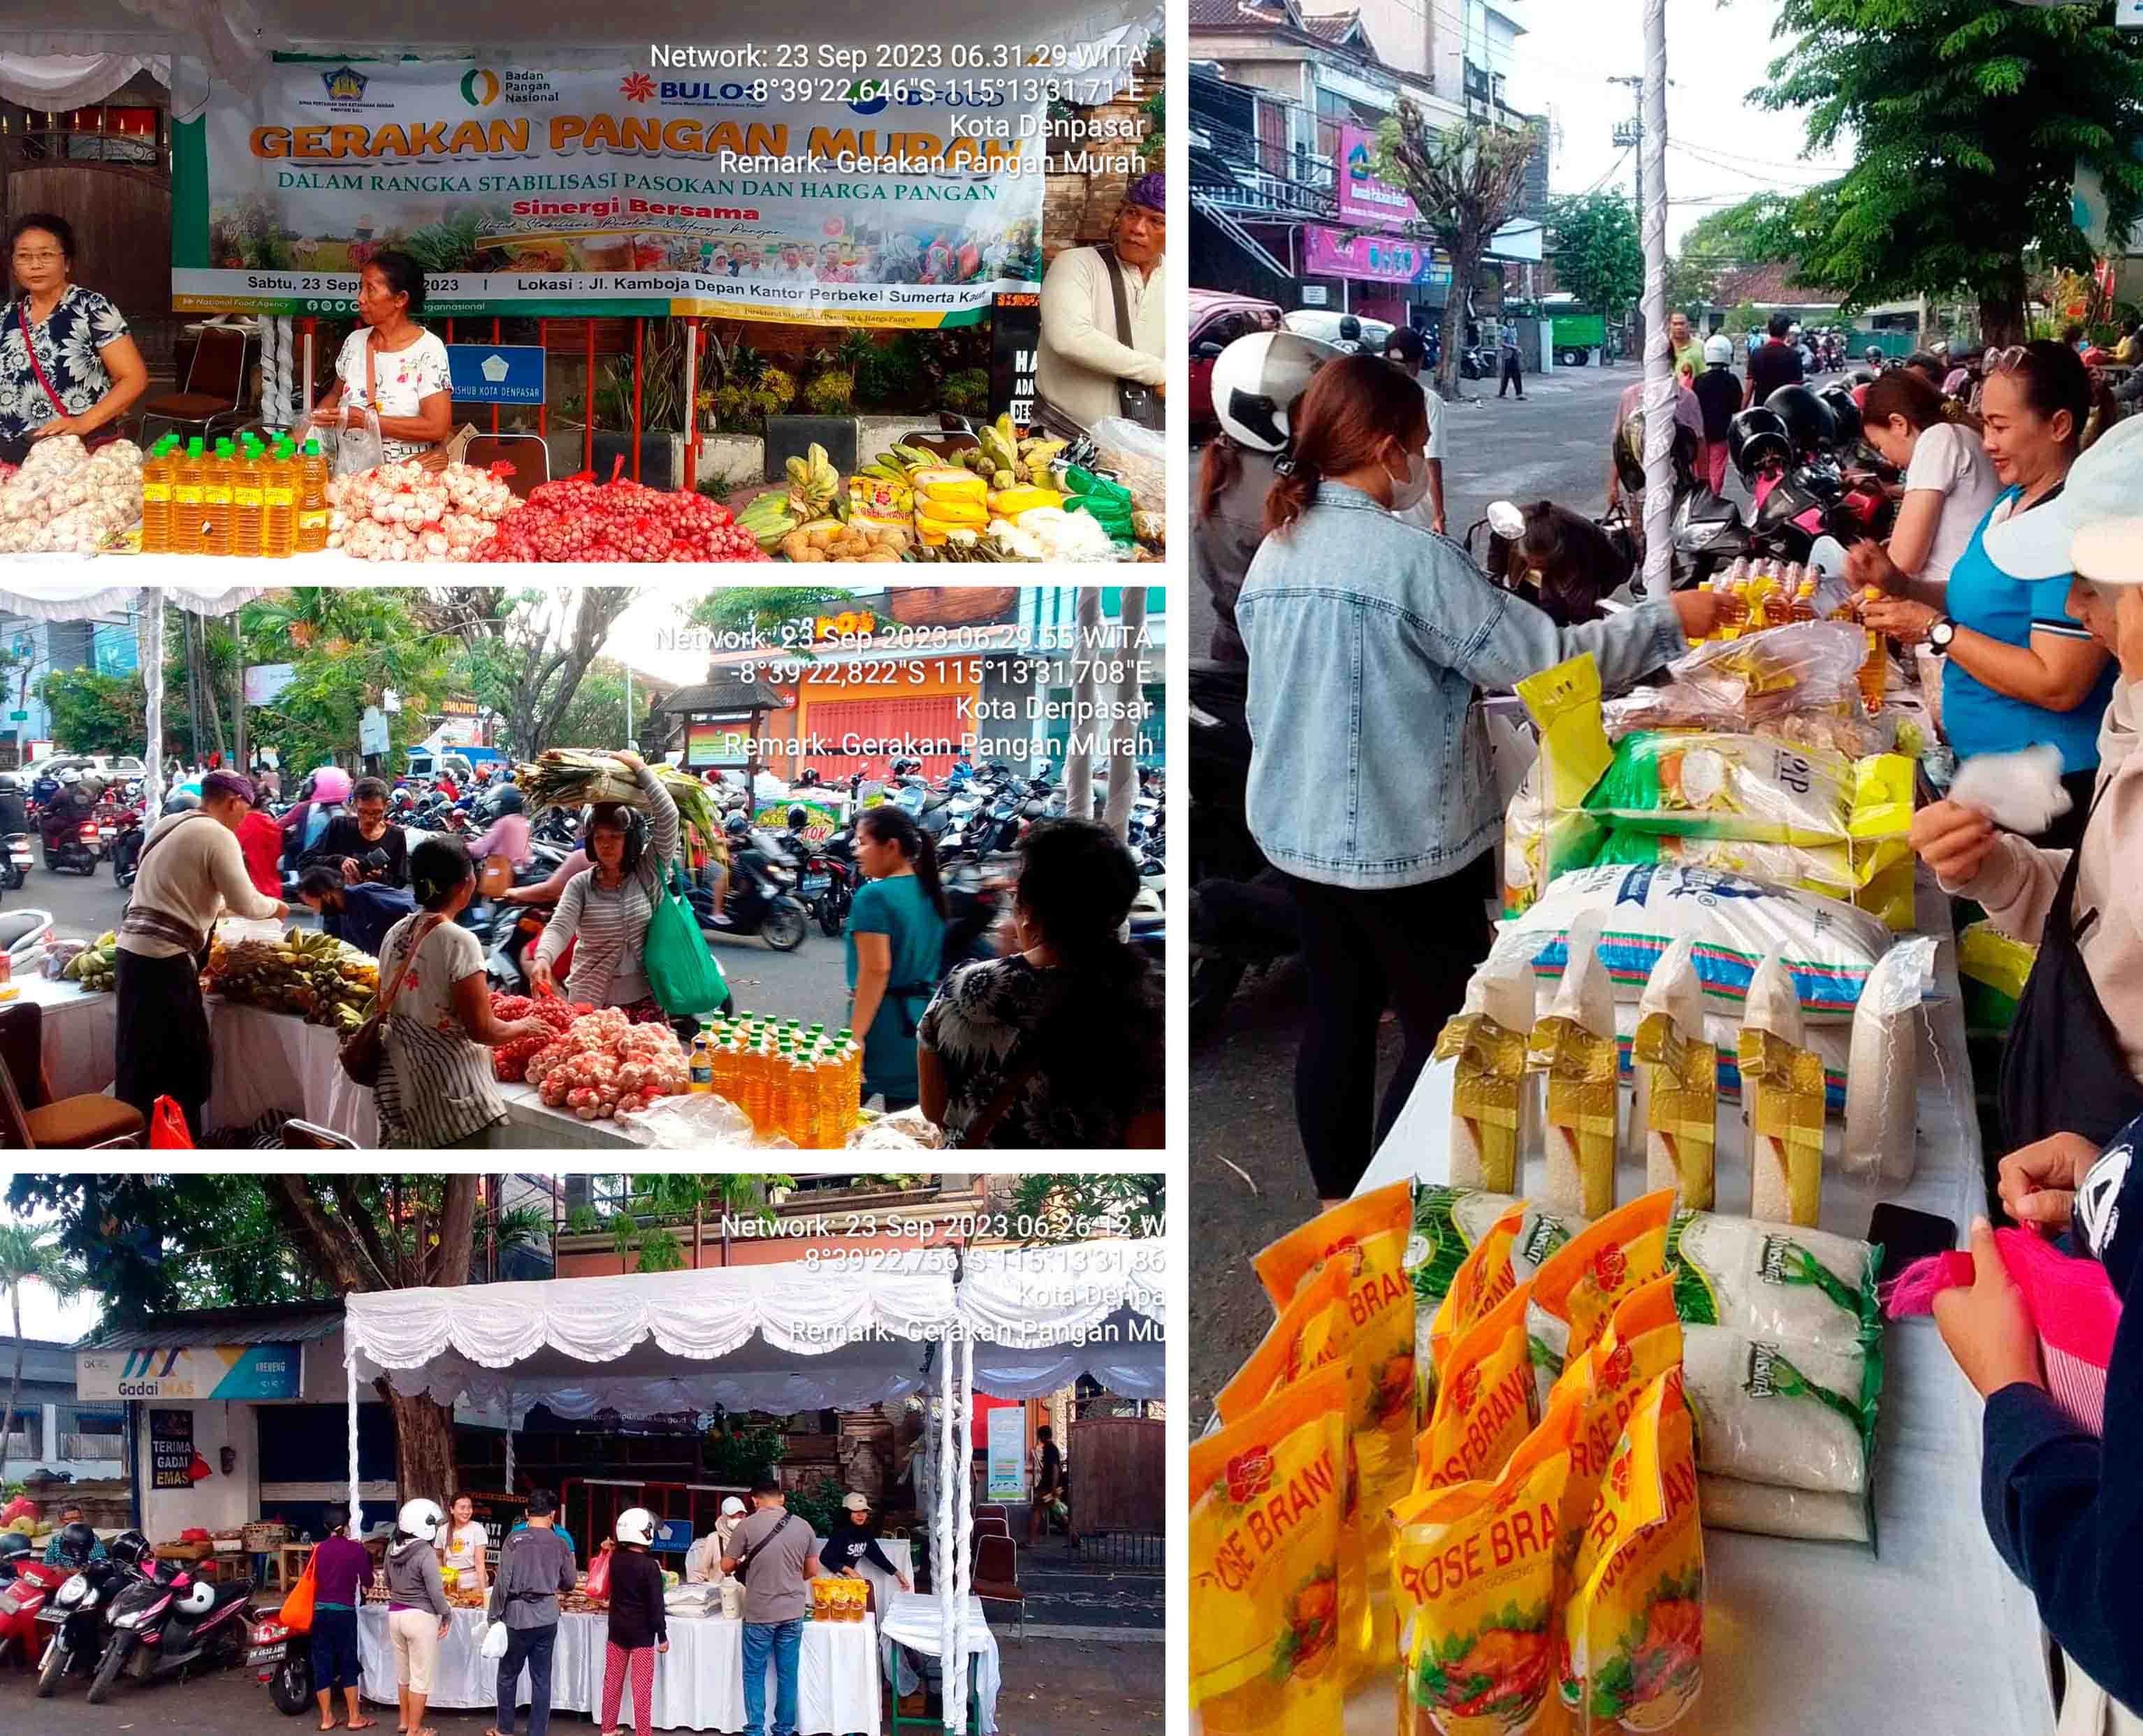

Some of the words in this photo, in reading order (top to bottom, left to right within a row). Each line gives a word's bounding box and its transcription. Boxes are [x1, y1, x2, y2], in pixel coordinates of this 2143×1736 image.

[505, 71, 544, 80] Badan
[505, 82, 551, 92] Pangan
[505, 92, 560, 103] Nasional
[249, 117, 530, 159] GERAKAN
[549, 112, 790, 156] PANGAN
[279, 173, 363, 190] DALAM
[370, 175, 472, 192] RANGKA
[479, 173, 616, 192] STABILISASI
[625, 173, 734, 195] PASOKAN
[743, 180, 794, 197] DAN
[800, 182, 887, 200] HARGA
[894, 184, 999, 201] PANGAN
[512, 197, 620, 217] Sinergi
[629, 198, 761, 220] Bersama
[247, 276, 296, 291] Sabtu,
[301, 277, 321, 290] 23
[517, 277, 574, 291] Lokasi
[588, 277, 609, 291] Jl.
[614, 277, 690, 293] Kamboja
[695, 278, 745, 296] Depan
[750, 284, 804, 299] Kantor
[809, 289, 884, 302] Perbekel
[889, 291, 955, 304] Sumerta
[479, 385, 498, 397] KOTA
[501, 386, 540, 398] DENPASAR
[1349, 1267, 1411, 1327] BRAN
[118, 1381, 158, 1396] Gadai
[1468, 1364, 1526, 1462] BRAN
[152, 1440, 191, 1454] TERIMA
[157, 1456, 189, 1468] GADAI
[157, 1472, 189, 1485] EMAS
[1247, 1447, 1335, 1554] BRAN
[1400, 1533, 1485, 1605] ROSE
[1490, 1503, 1560, 1567] BRA
